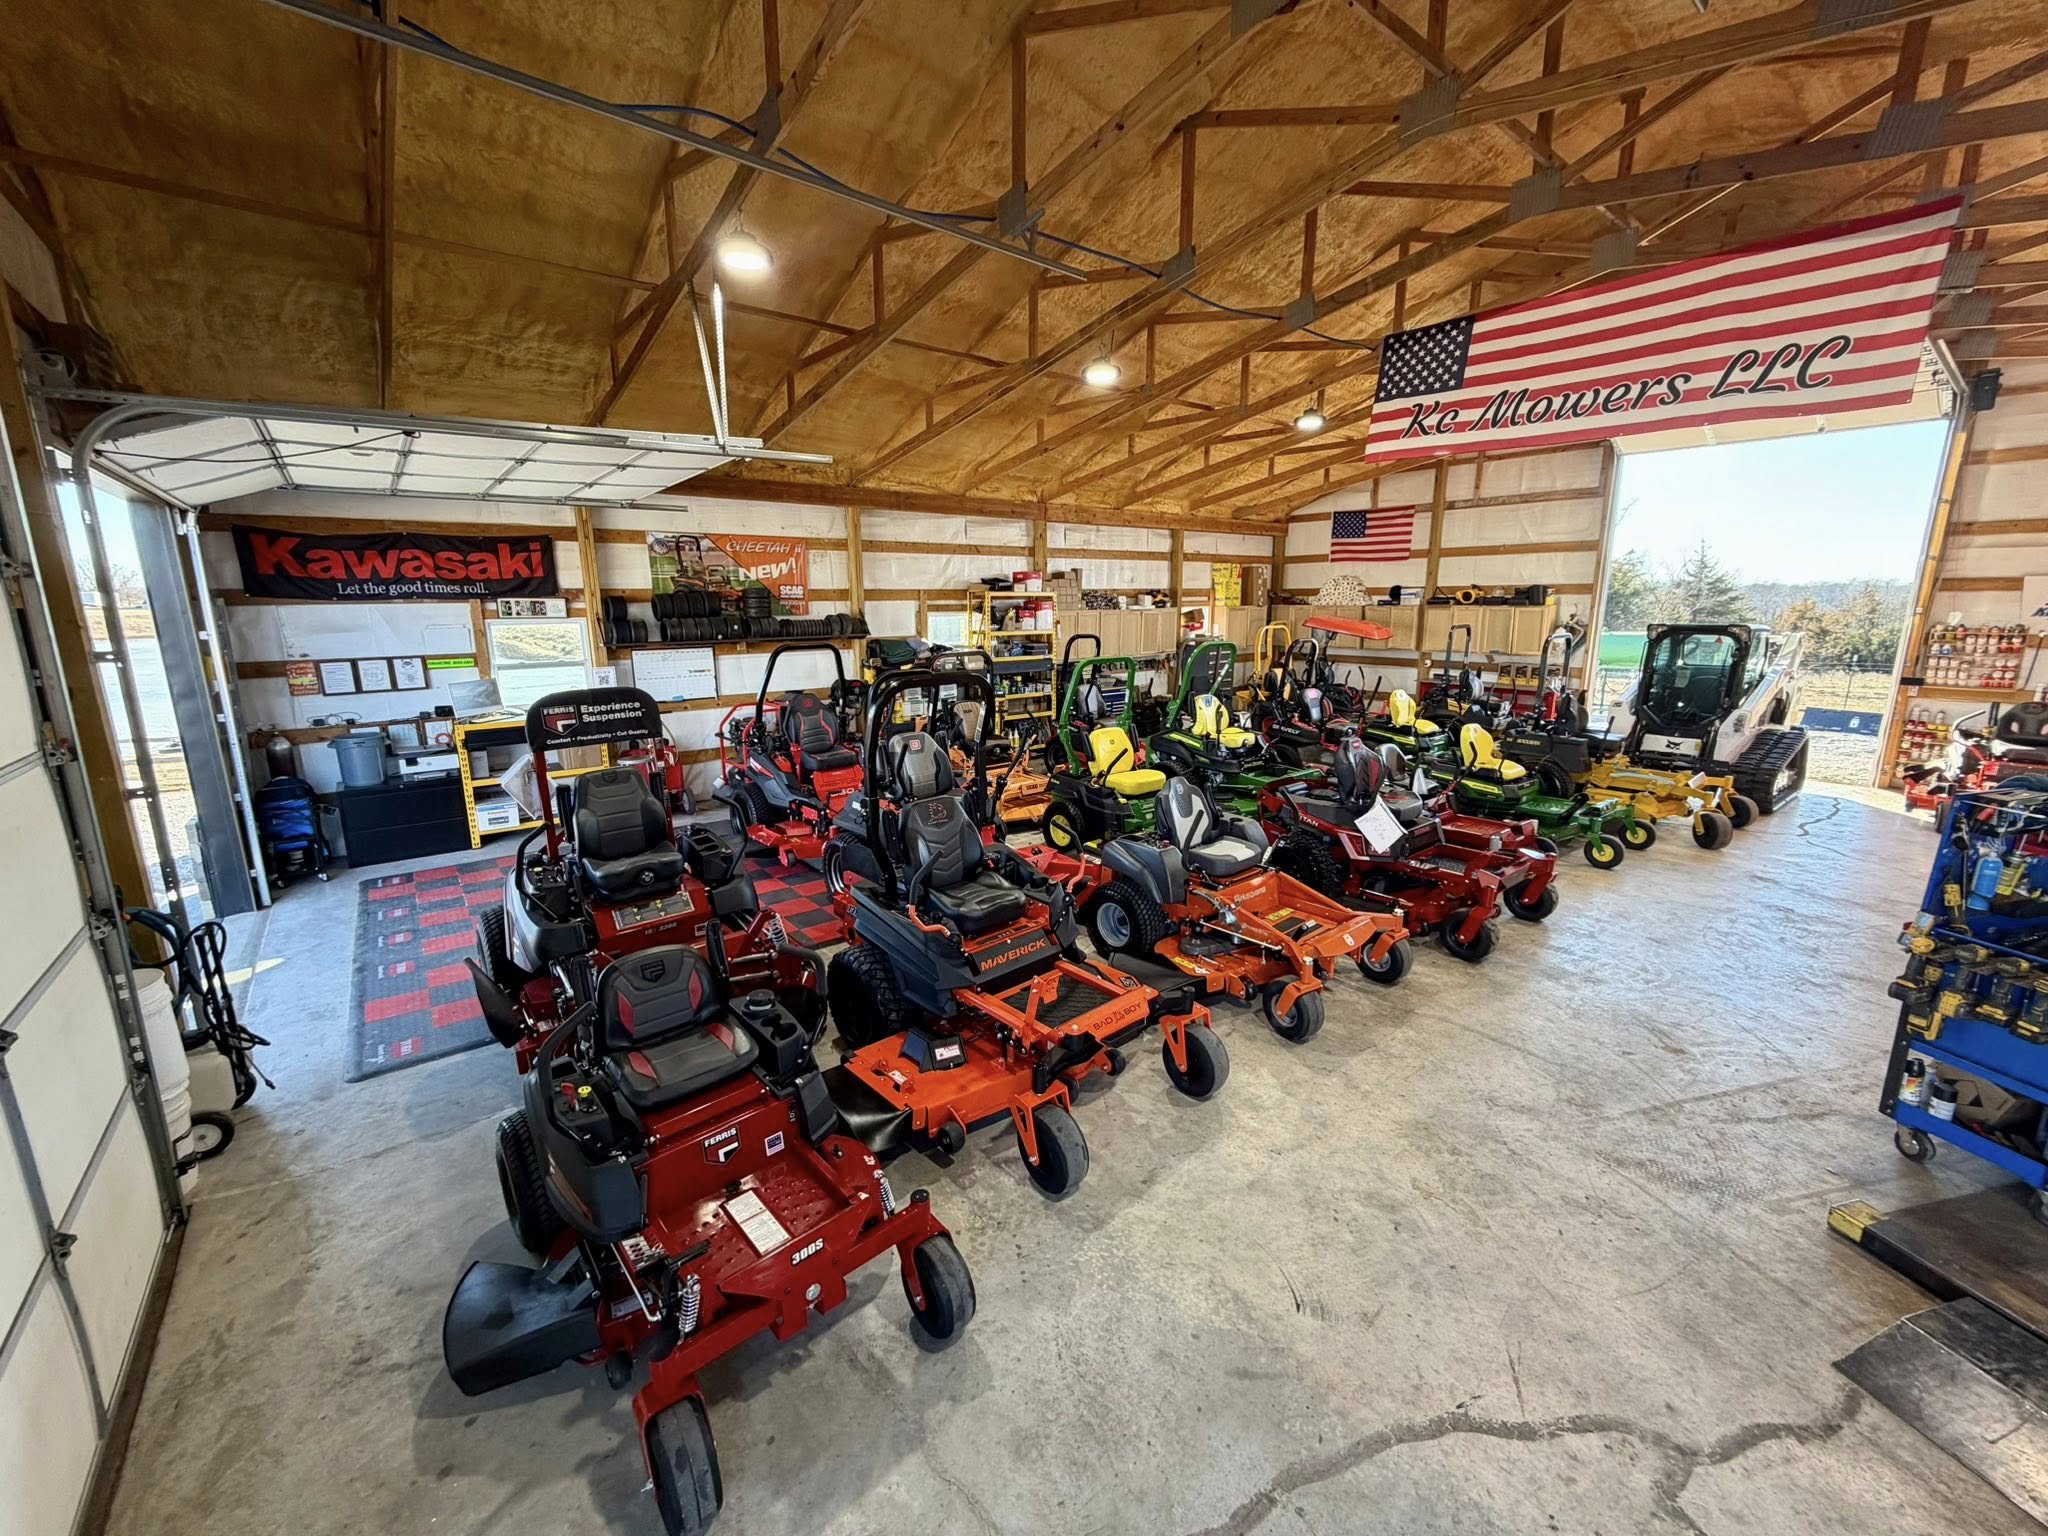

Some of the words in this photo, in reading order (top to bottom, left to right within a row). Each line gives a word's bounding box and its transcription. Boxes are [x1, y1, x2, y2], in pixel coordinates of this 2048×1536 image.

[1400, 403, 1459, 439] Kc
[1466, 370, 1693, 434] Mowers
[1707, 334, 1853, 401] LLC
[251, 533, 544, 579] Kawasaki
[726, 540, 791, 554] CHEETAH
[337, 582, 360, 595] Let
[363, 582, 386, 595] the
[389, 581, 423, 598] good
[424, 581, 462, 595] times
[463, 582, 489, 595] roll.
[779, 585, 804, 595] SCAG
[543, 706, 575, 715] FERRIS
[580, 702, 641, 714] Experience
[577, 733, 612, 741] Productivity
[980, 938, 1047, 971] MAVERICK
[1093, 1016, 1113, 1031] BAD
[1125, 1002, 1142, 1016] BOY
[704, 1127, 737, 1148] FERRIS
[791, 1237, 824, 1266] 300S
